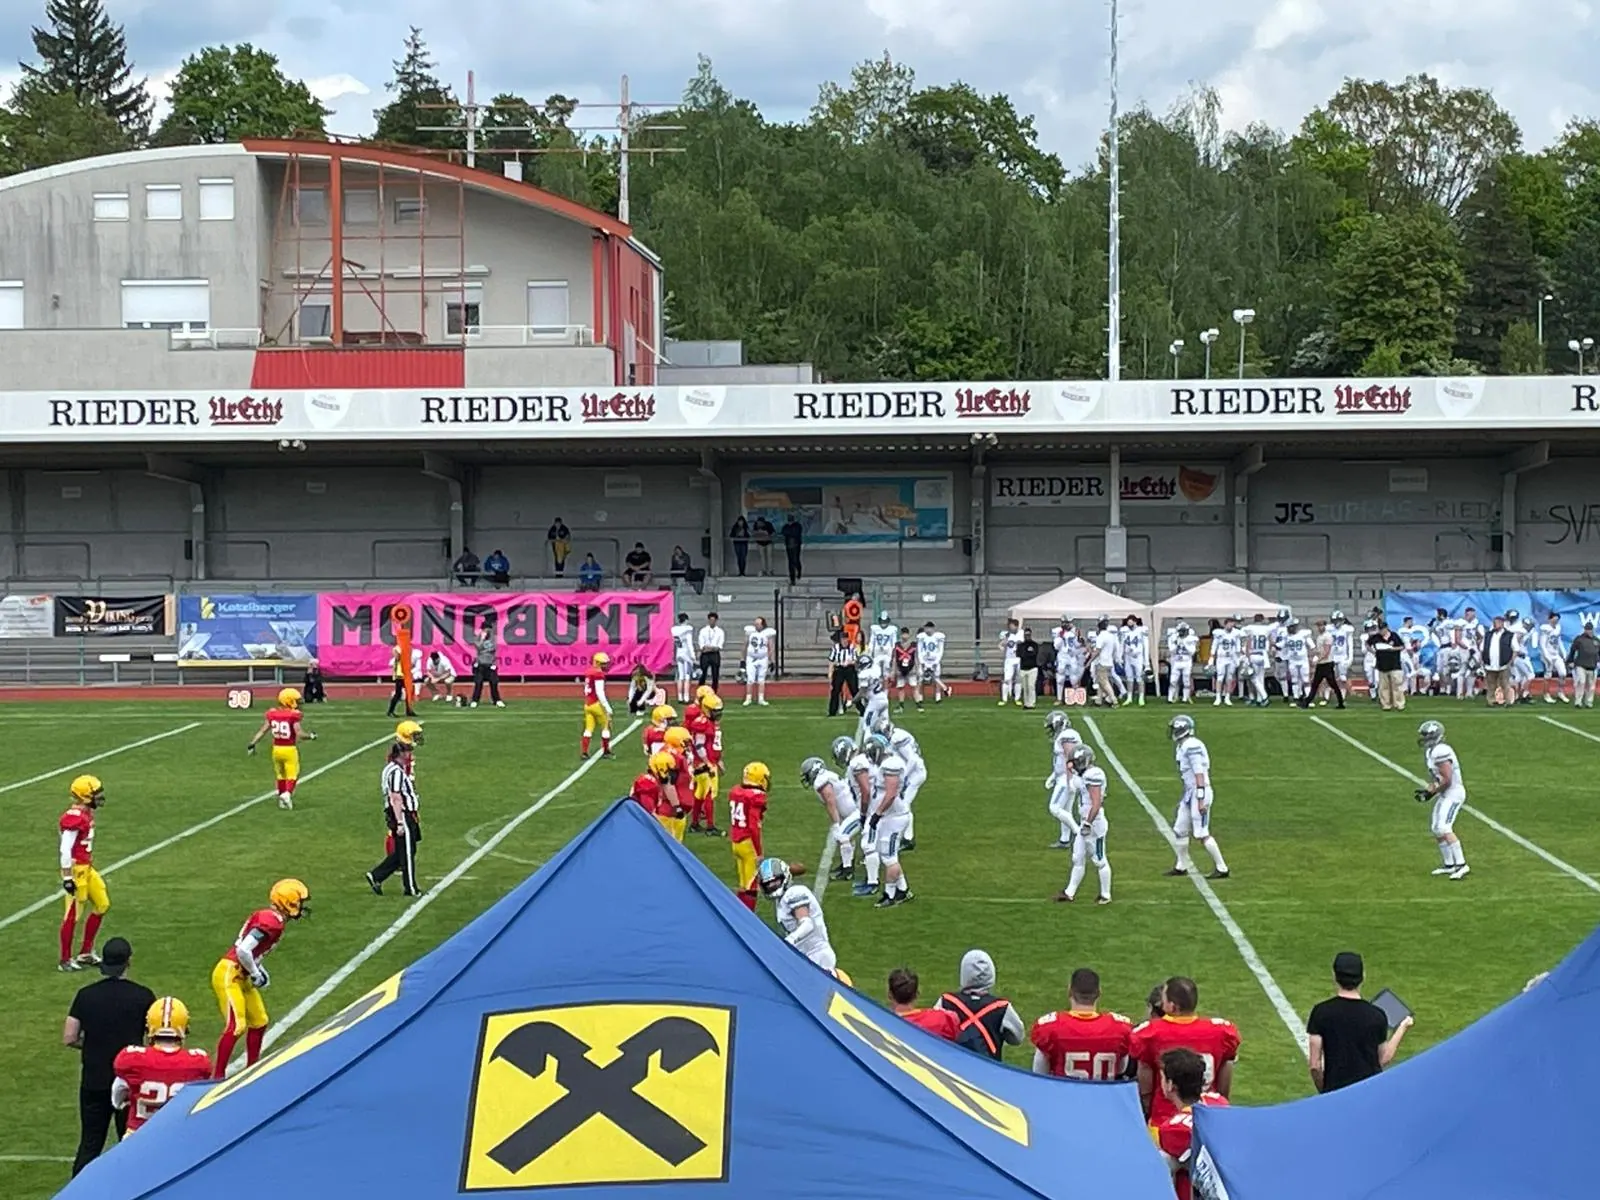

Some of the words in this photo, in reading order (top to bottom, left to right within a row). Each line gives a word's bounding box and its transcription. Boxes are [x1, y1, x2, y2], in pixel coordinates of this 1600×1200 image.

[48, 398, 200, 427] RIEDER
[208, 395, 284, 425] UrEcht
[420, 395, 572, 424] RIEDER
[580, 391, 656, 422] UrEcht
[793, 391, 946, 419] RIEDER
[954, 387, 1033, 418] UrEcht
[1170, 387, 1325, 415] RIEDER
[1333, 383, 1413, 415] UrEcht
[996, 476, 1105, 497] RIEDER
[1274, 502, 1314, 524] JFS
[271, 720, 292, 739] 29
[1065, 1051, 1117, 1081] 50
